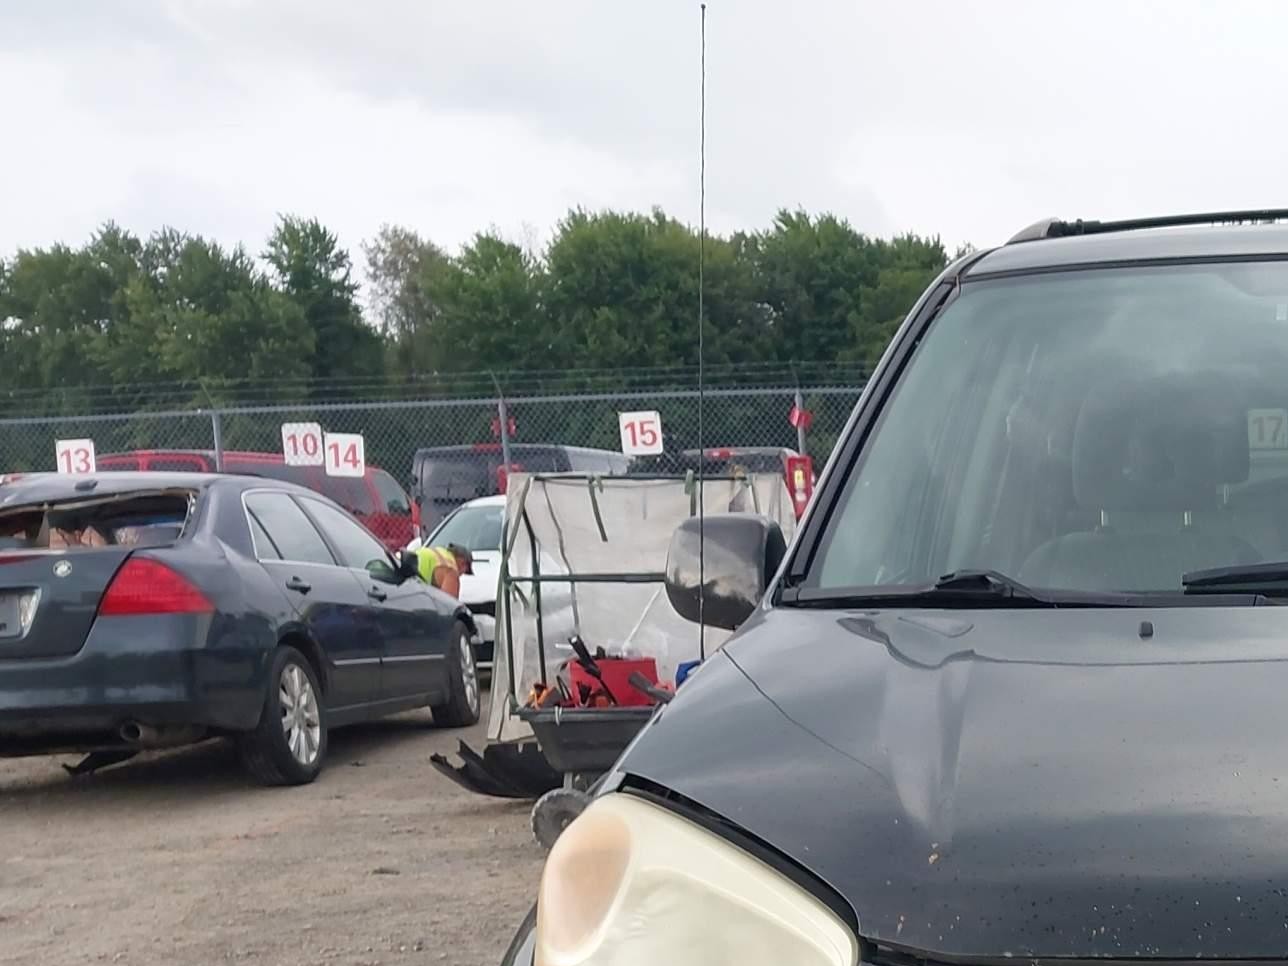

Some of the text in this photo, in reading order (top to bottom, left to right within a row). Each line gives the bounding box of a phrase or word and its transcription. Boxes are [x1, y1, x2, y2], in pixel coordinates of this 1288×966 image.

[624, 421, 657, 447] 15
[1253, 415, 1283, 442] 17
[286, 432, 319, 457] 10
[327, 442, 361, 470] 14
[60, 448, 92, 472] 13
